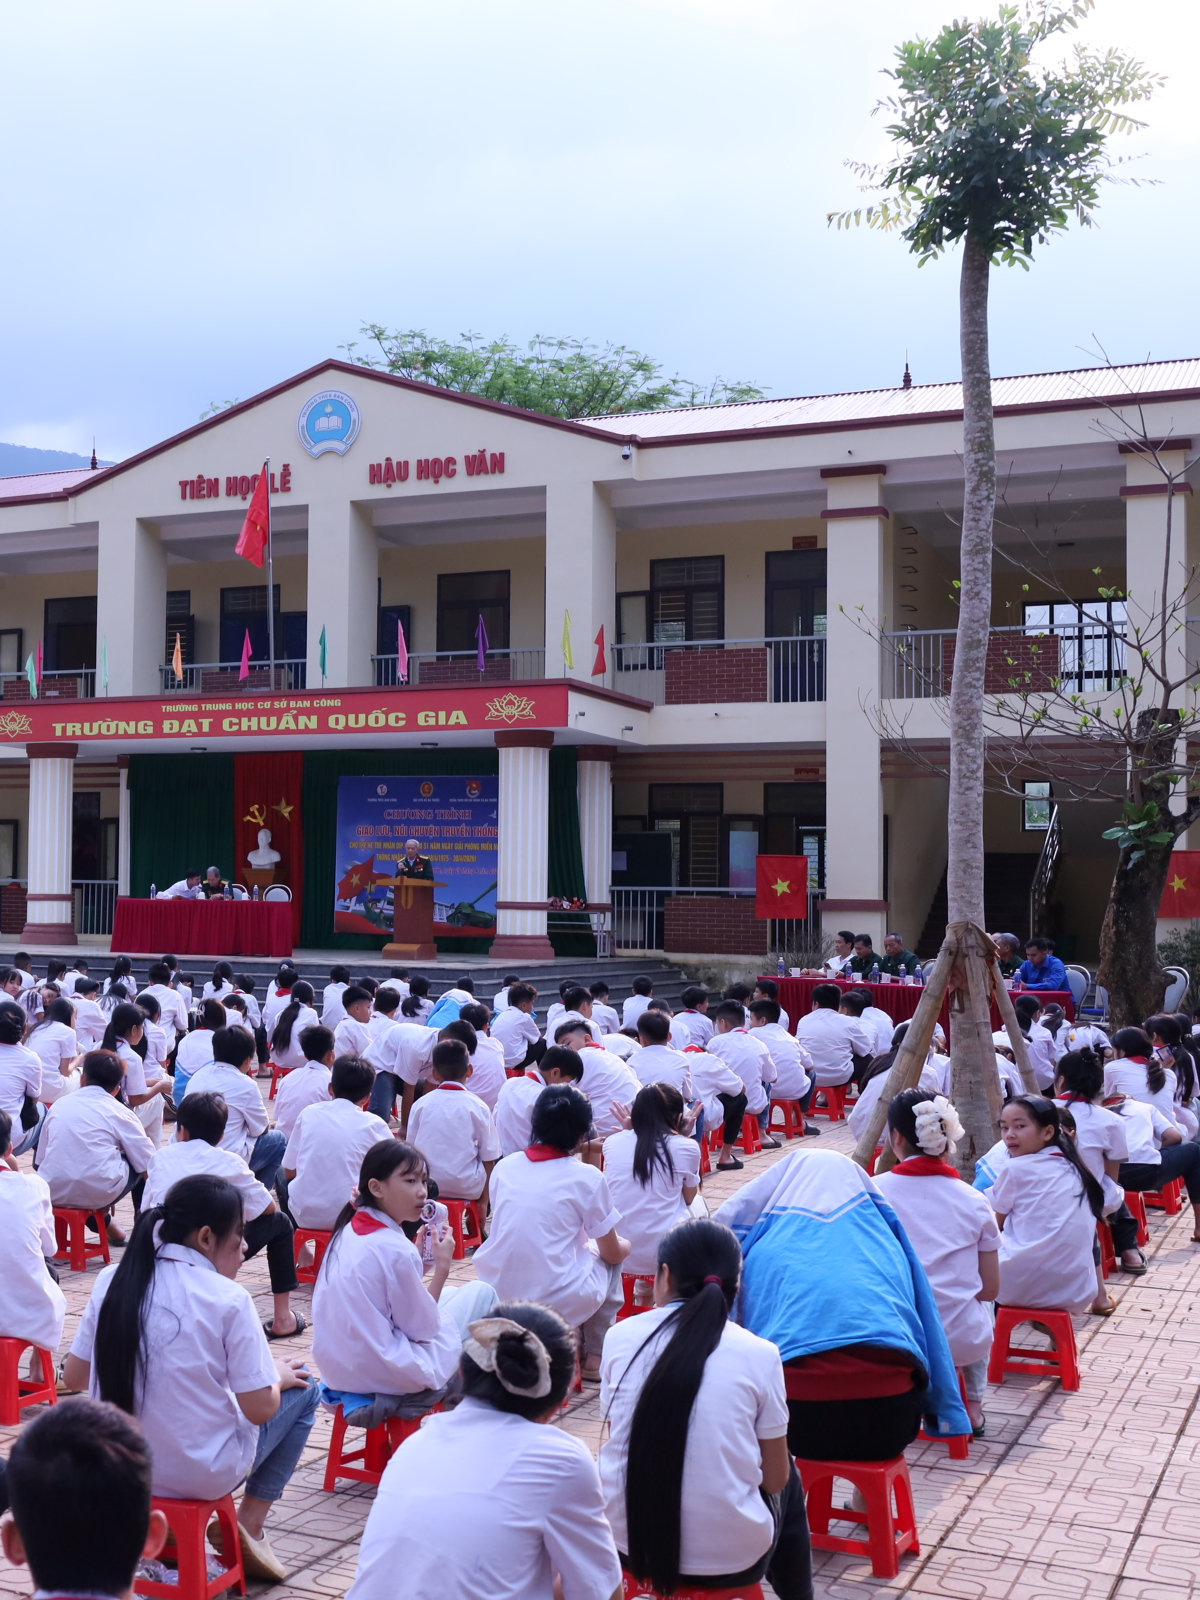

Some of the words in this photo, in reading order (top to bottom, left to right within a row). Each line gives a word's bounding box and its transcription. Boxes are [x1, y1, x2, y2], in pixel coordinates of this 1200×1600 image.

[369, 457, 409, 488] HẬU
[416, 456, 457, 484] HỌC
[464, 448, 506, 476] VĂN
[178, 474, 219, 500] TIÊN
[161, 703, 198, 713] TRƯỜNG
[201, 702, 233, 712] TRUNG
[235, 702, 255, 712] HỌC
[257, 700, 272, 710] CƠ
[273, 698, 288, 709] SỞ
[289, 700, 311, 708] BAN
[313, 698, 342, 707] CÔNG
[52, 717, 154, 737] TRƯỜNG
[162, 718, 213, 737] ĐẠT
[222, 710, 318, 732] CHUẨN
[327, 707, 407, 730] QUỐC
[416, 710, 469, 727] GIA
[383, 808, 434, 820] CHƯƠNG
[435, 807, 473, 820] TRÌNH
[356, 825, 375, 837] GIAO
[393, 823, 408, 837] NÓI
[409, 823, 440, 839] CHUYỆN
